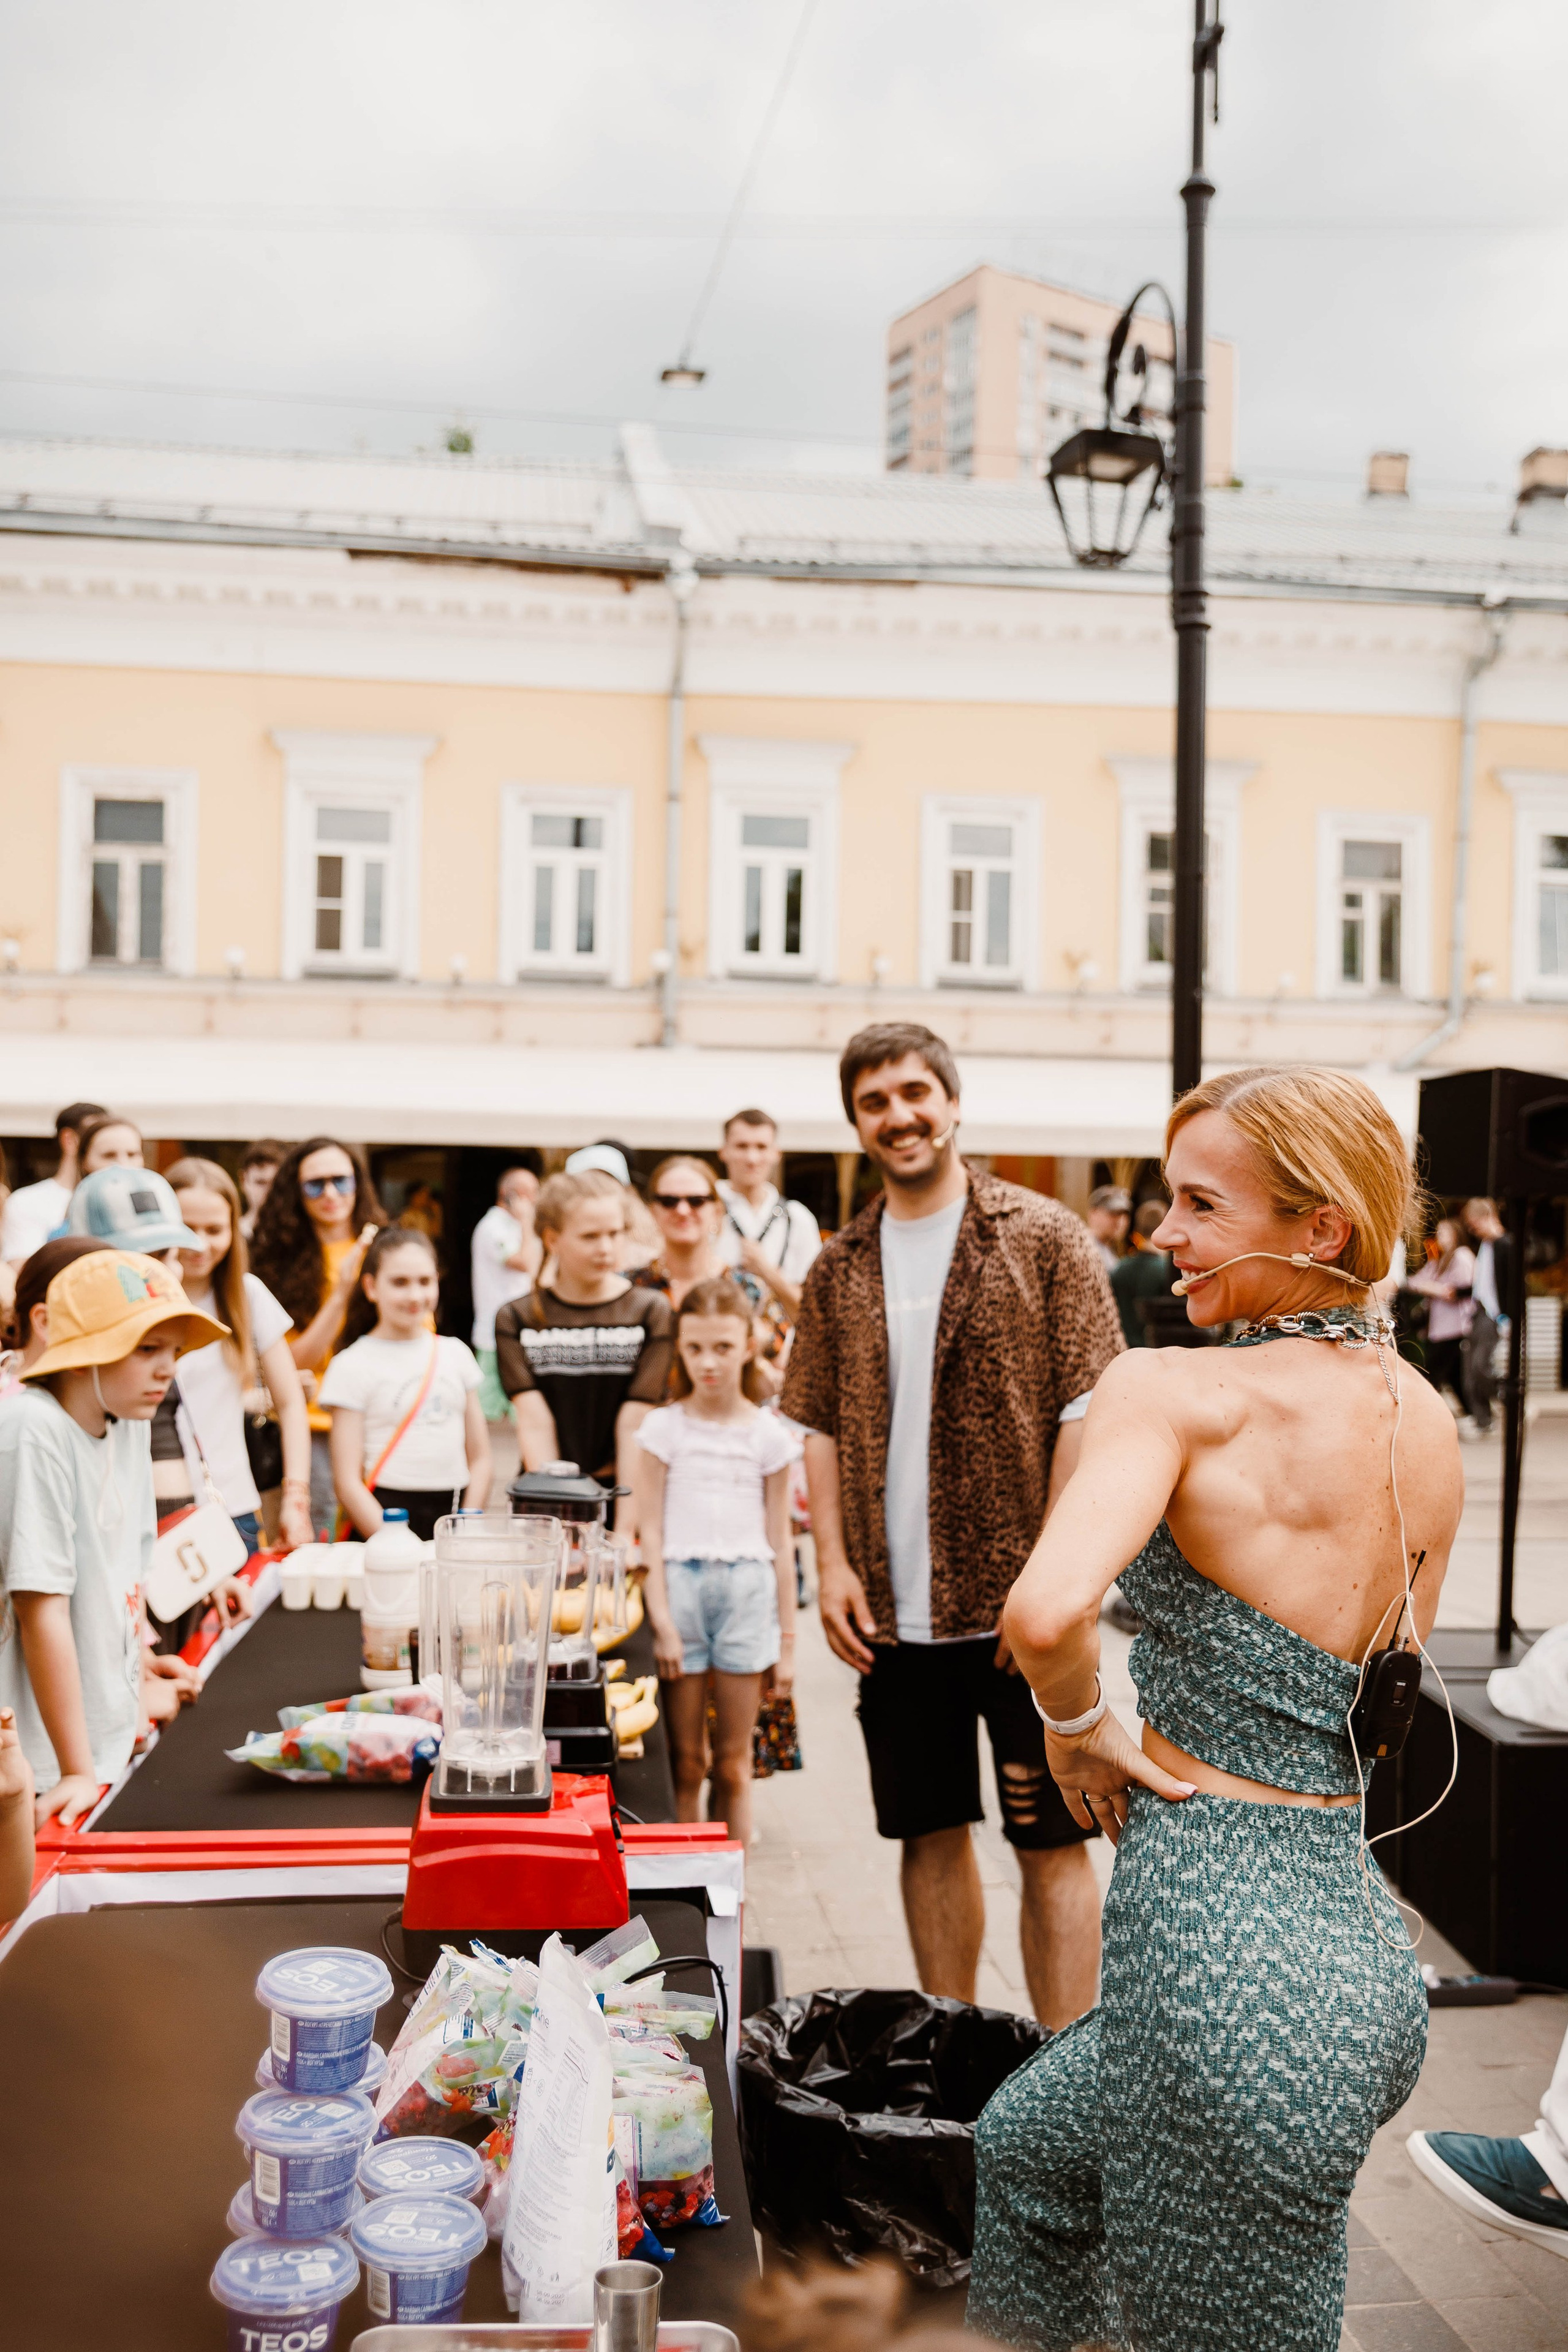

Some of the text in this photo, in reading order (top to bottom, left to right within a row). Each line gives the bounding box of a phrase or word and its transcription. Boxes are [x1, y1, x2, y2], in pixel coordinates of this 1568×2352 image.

[253, 2100, 328, 2128] TEO
[366, 2223, 461, 2247] TEOS
[229, 2248, 339, 2274] TEOS
[239, 2323, 328, 2352] TEOS
